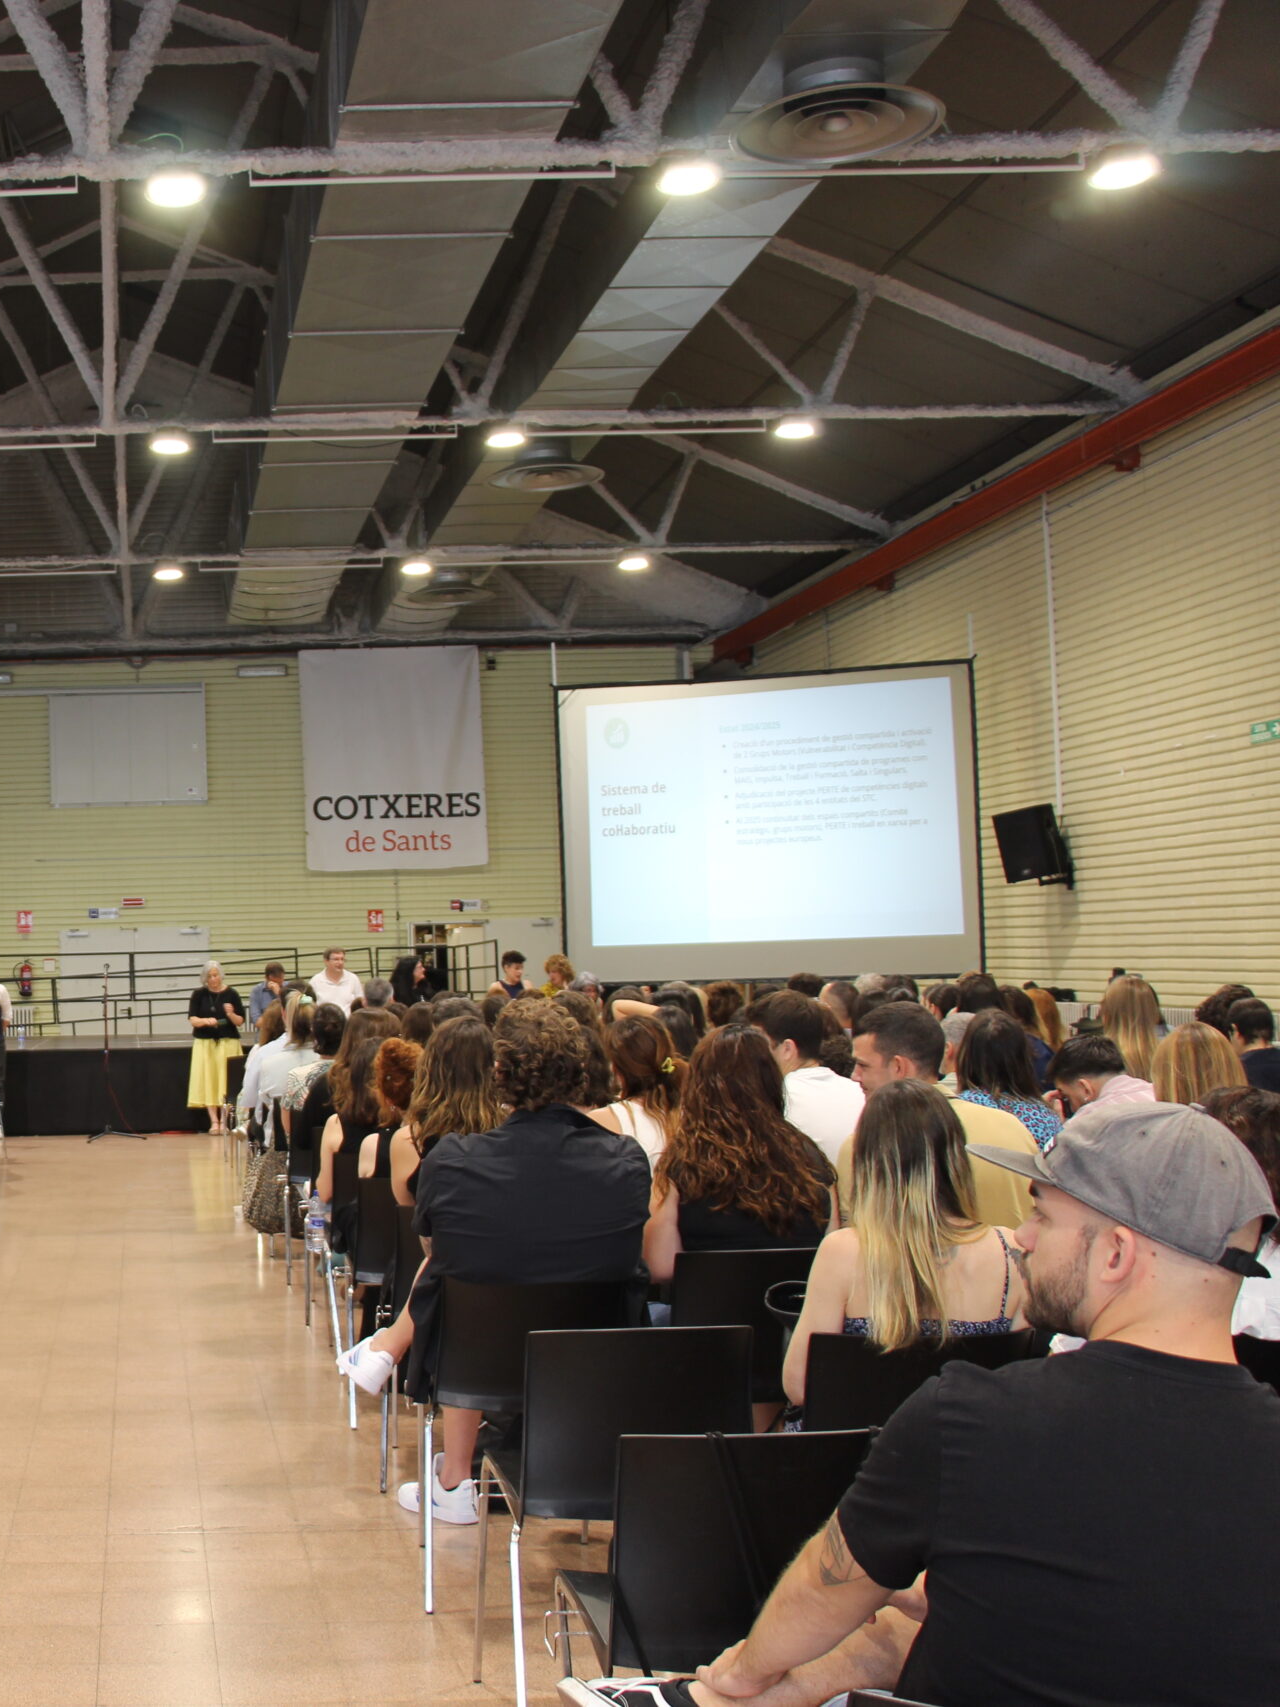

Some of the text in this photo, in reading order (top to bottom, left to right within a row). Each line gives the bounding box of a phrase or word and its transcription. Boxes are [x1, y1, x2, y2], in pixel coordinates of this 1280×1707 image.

[601, 782, 667, 797] Sistema de
[313, 792, 481, 821] COTXERES
[601, 803, 642, 817] treball
[345, 829, 452, 853] de Sants
